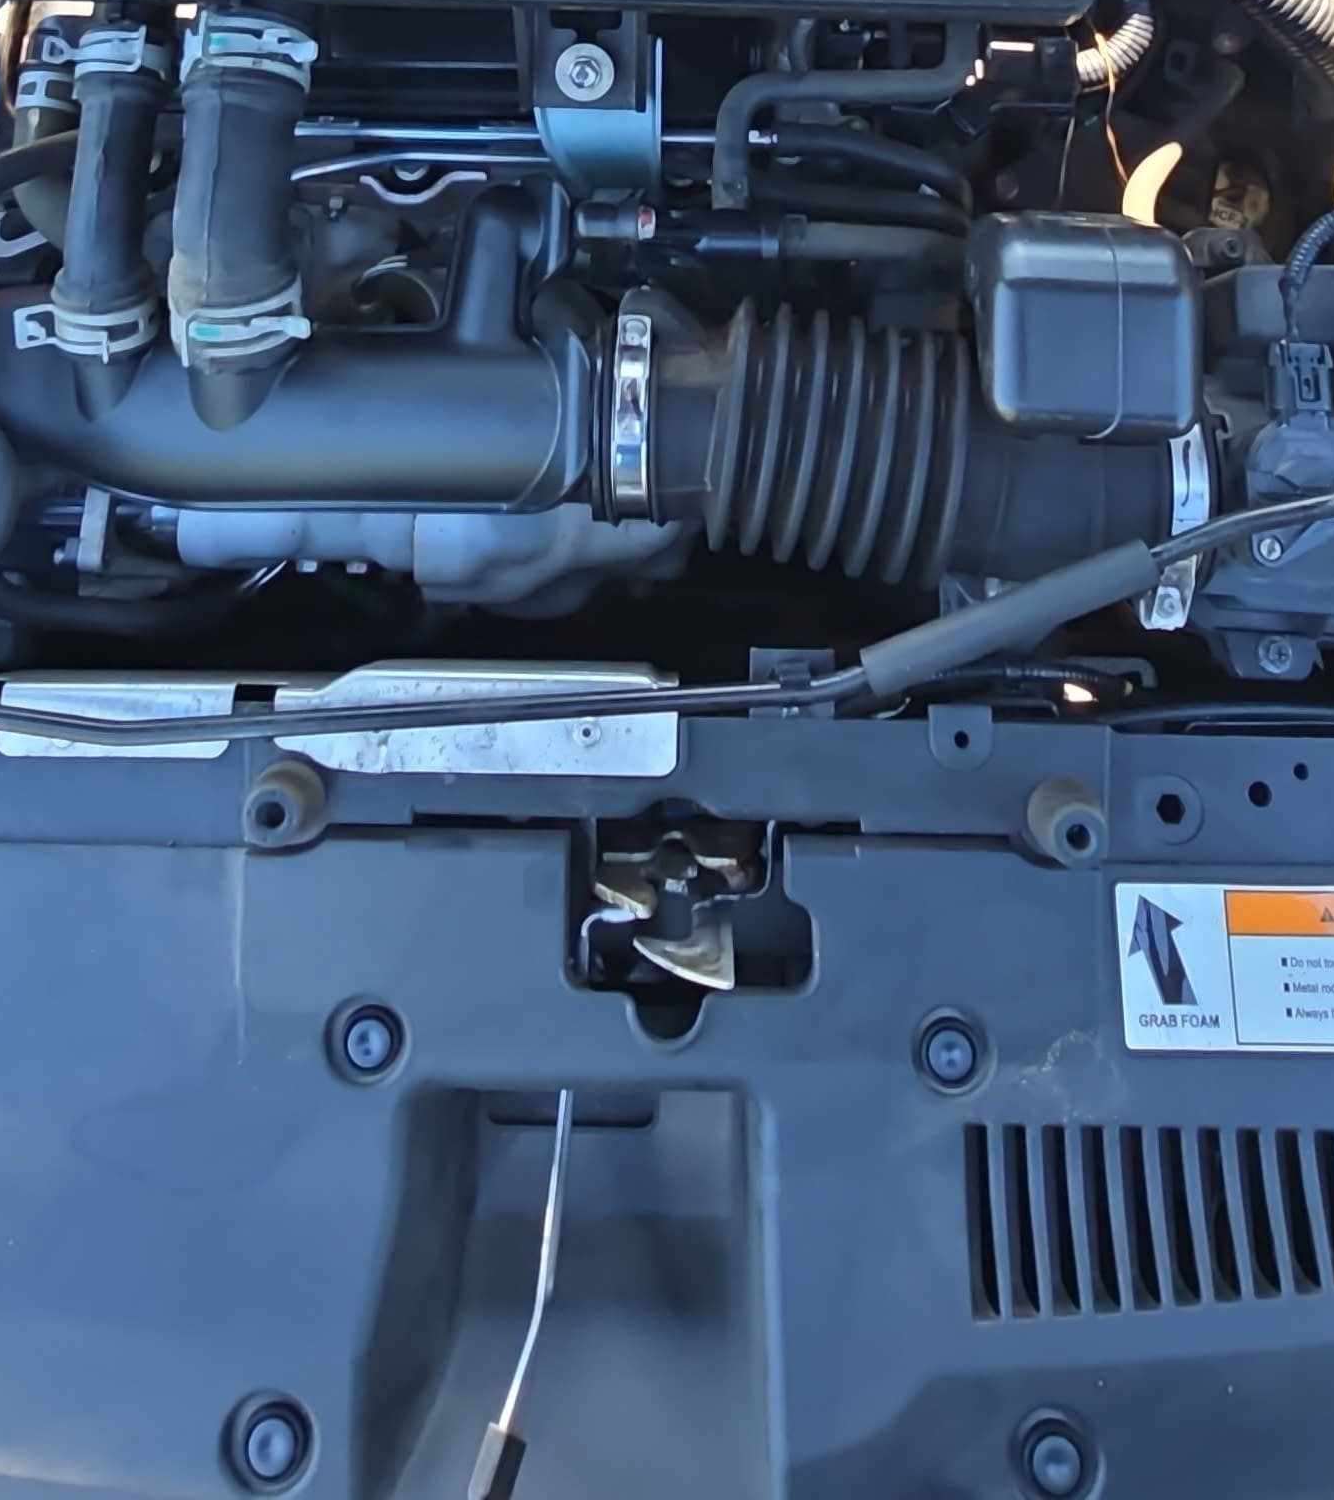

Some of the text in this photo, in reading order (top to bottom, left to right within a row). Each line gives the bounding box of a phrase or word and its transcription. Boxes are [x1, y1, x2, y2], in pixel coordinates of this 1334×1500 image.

[1290, 957, 1304, 968] Do
[1307, 957, 1322, 968] not
[1292, 982, 1318, 993] Metal
[1295, 1008, 1329, 1021] Always
[1139, 1013, 1220, 1029] GRAB FOAM
